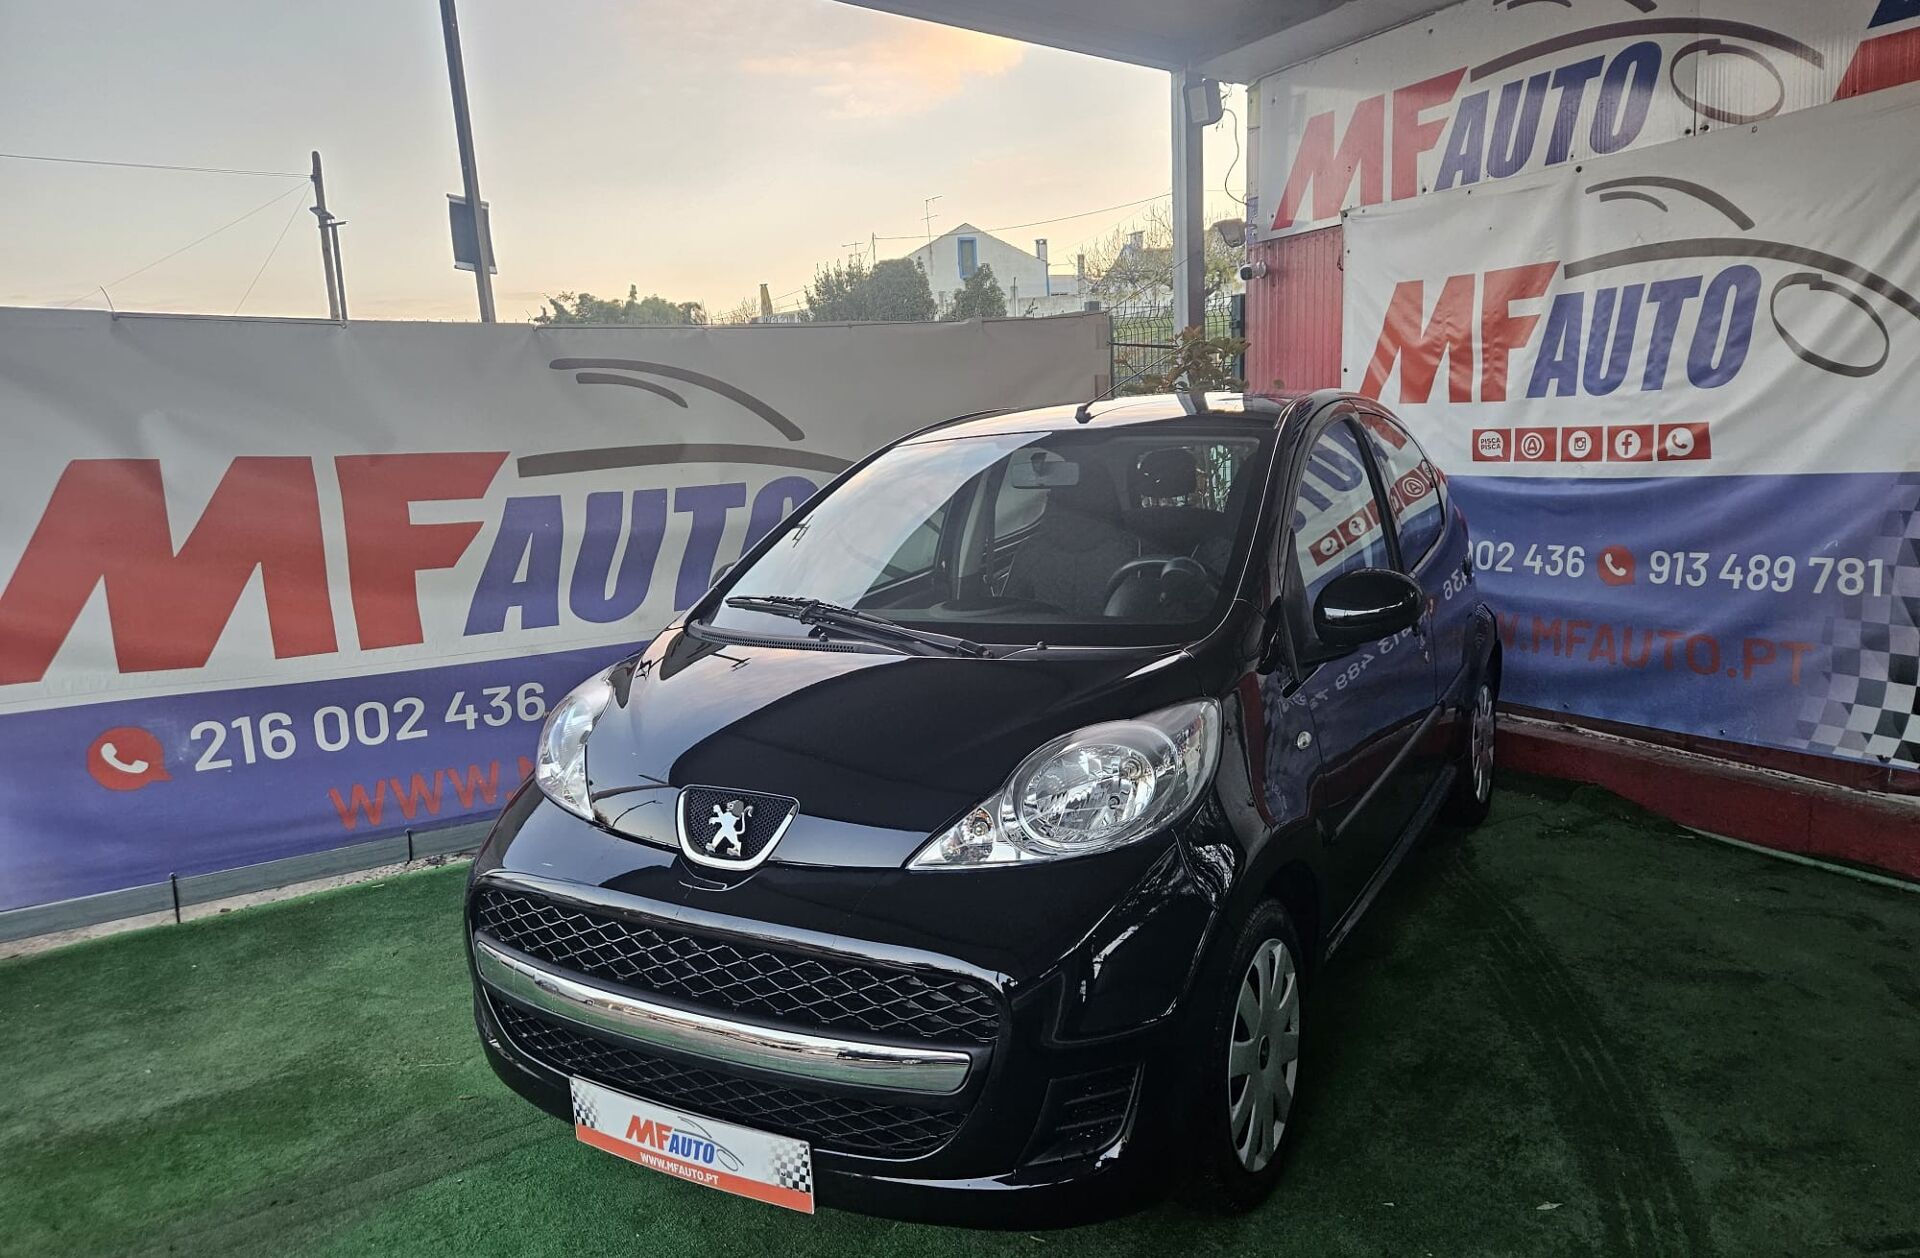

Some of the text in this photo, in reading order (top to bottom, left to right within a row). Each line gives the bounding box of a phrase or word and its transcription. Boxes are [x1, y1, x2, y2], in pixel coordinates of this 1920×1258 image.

[1467, 540, 1586, 577] 02 436
[1649, 550, 1884, 597] 913 489 781
[189, 682, 546, 772] 216 002 436
[640, 1151, 719, 1185] WWW.MFAUTO.PT
